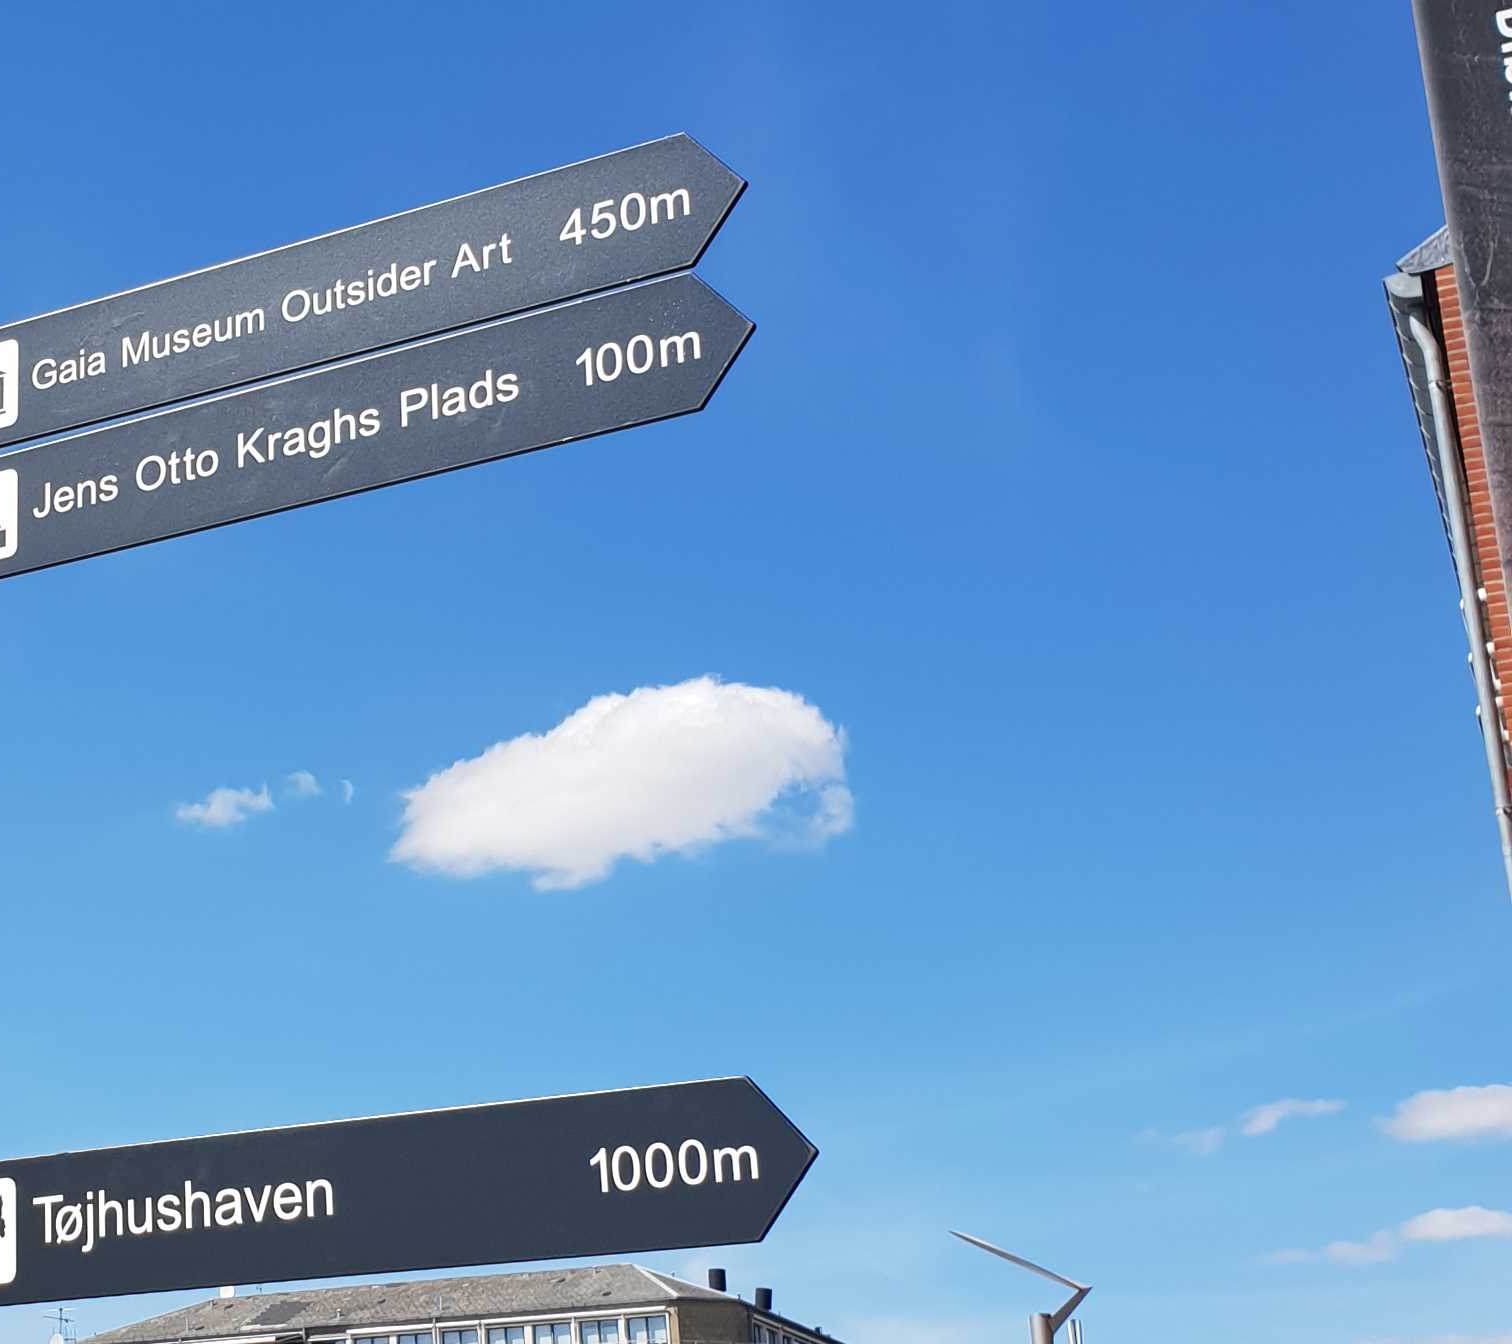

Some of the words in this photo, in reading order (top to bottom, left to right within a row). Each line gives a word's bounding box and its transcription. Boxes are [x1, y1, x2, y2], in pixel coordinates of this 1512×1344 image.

[31, 351, 106, 390] Gaia
[121, 308, 265, 368] Museum
[281, 259, 437, 323] Outsider
[450, 232, 513, 279] Art
[559, 187, 691, 246] 450m
[32, 474, 119, 519] Jens
[135, 447, 219, 492] Otto
[237, 407, 381, 469] Kraghs
[400, 369, 520, 428] Plads
[575, 331, 701, 387] 100m
[32, 1178, 334, 1253] Tøjhushaven
[589, 1138, 760, 1193] 1000m
